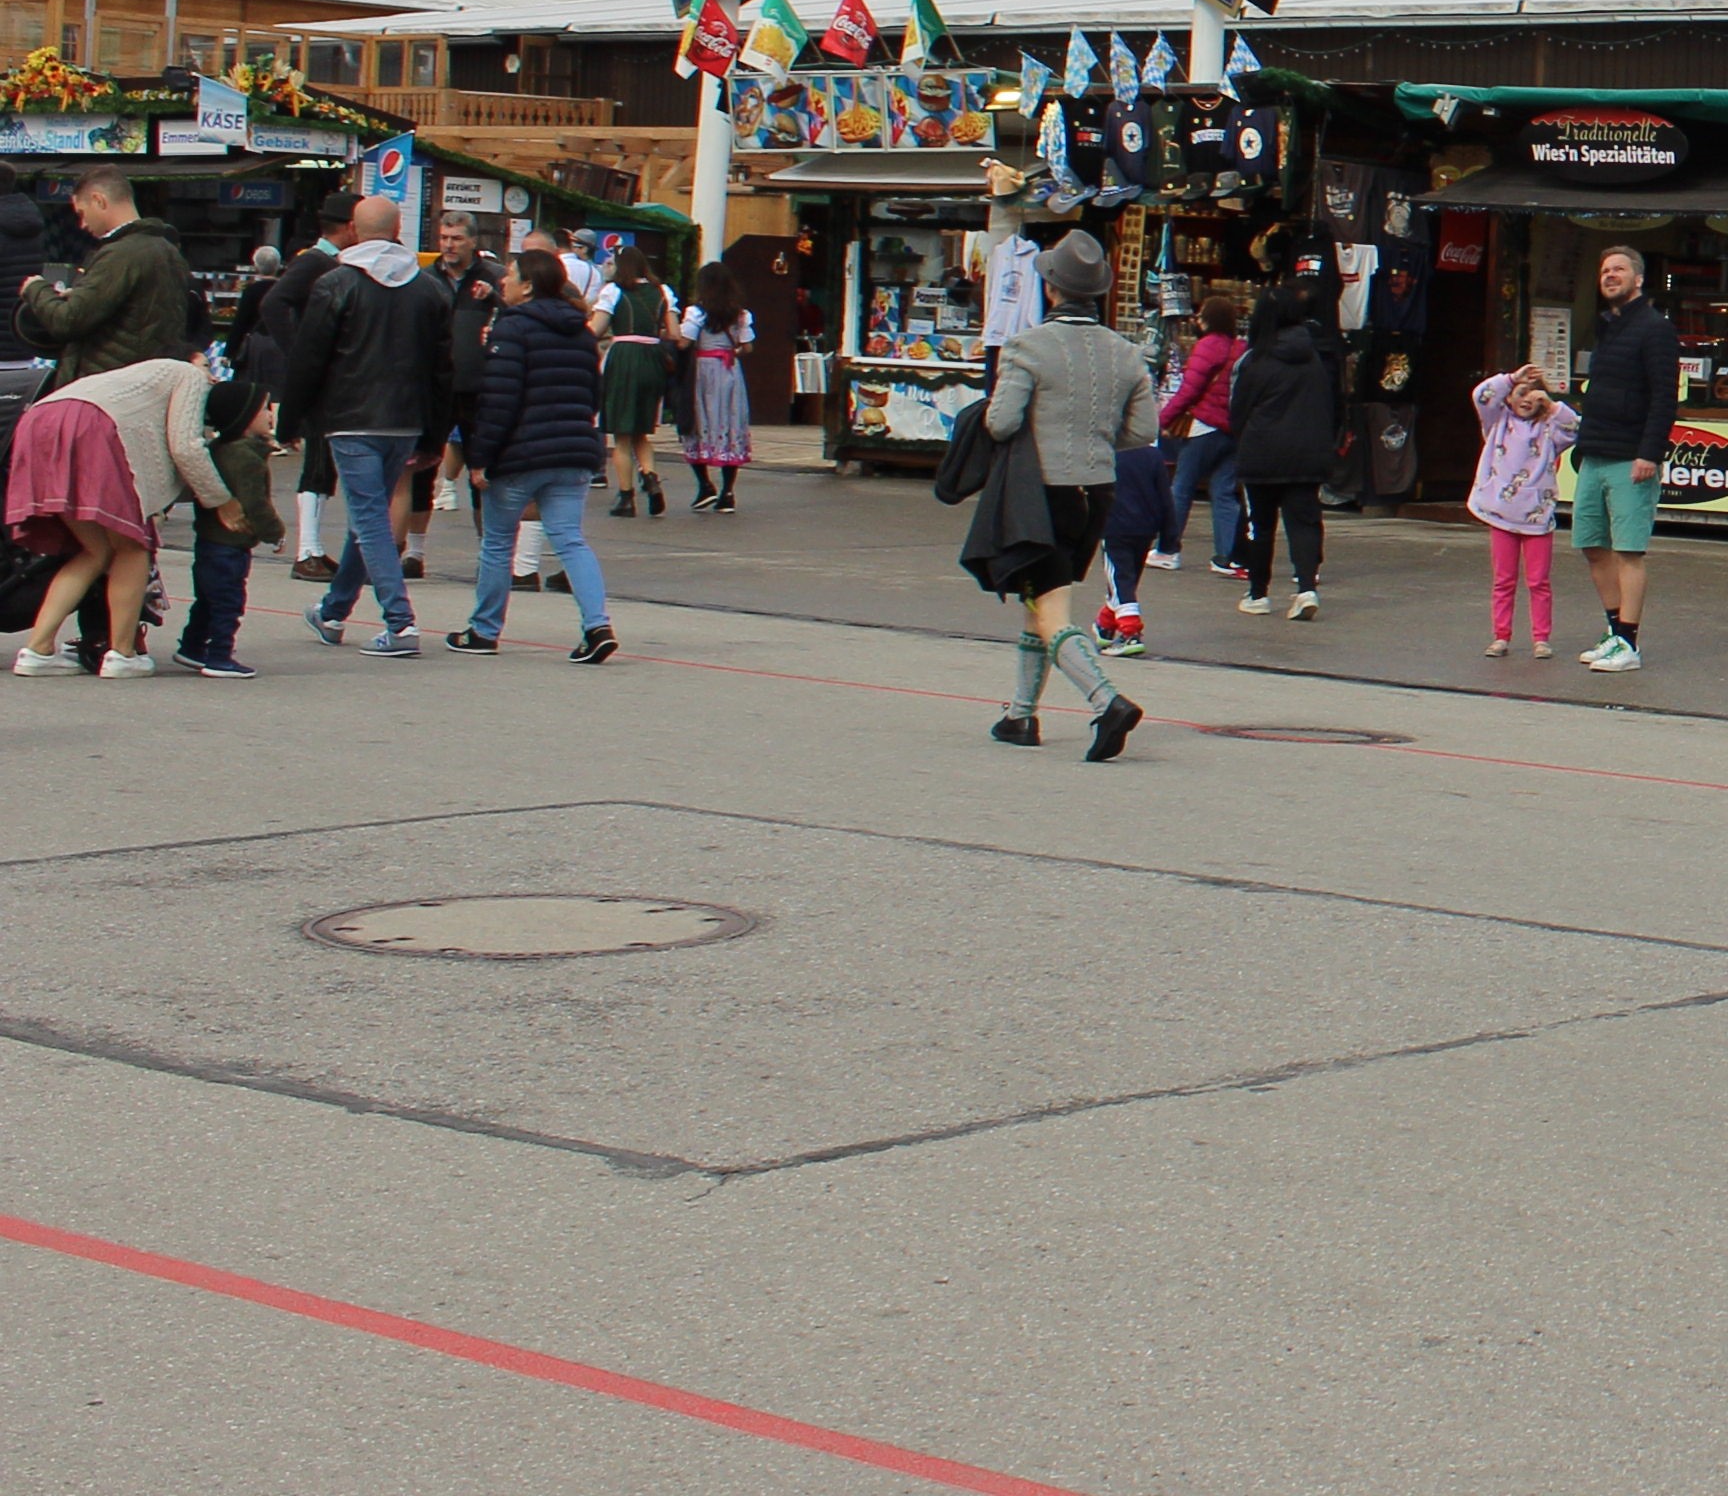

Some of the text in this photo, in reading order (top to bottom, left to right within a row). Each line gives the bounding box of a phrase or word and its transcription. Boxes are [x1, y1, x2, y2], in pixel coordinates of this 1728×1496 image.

[200, 108, 245, 130] KÄSE
[1557, 115, 1657, 144] Traditionelle
[253, 134, 311, 150] Gebäck
[1532, 144, 1676, 166] Wies'n Spezialitäten
